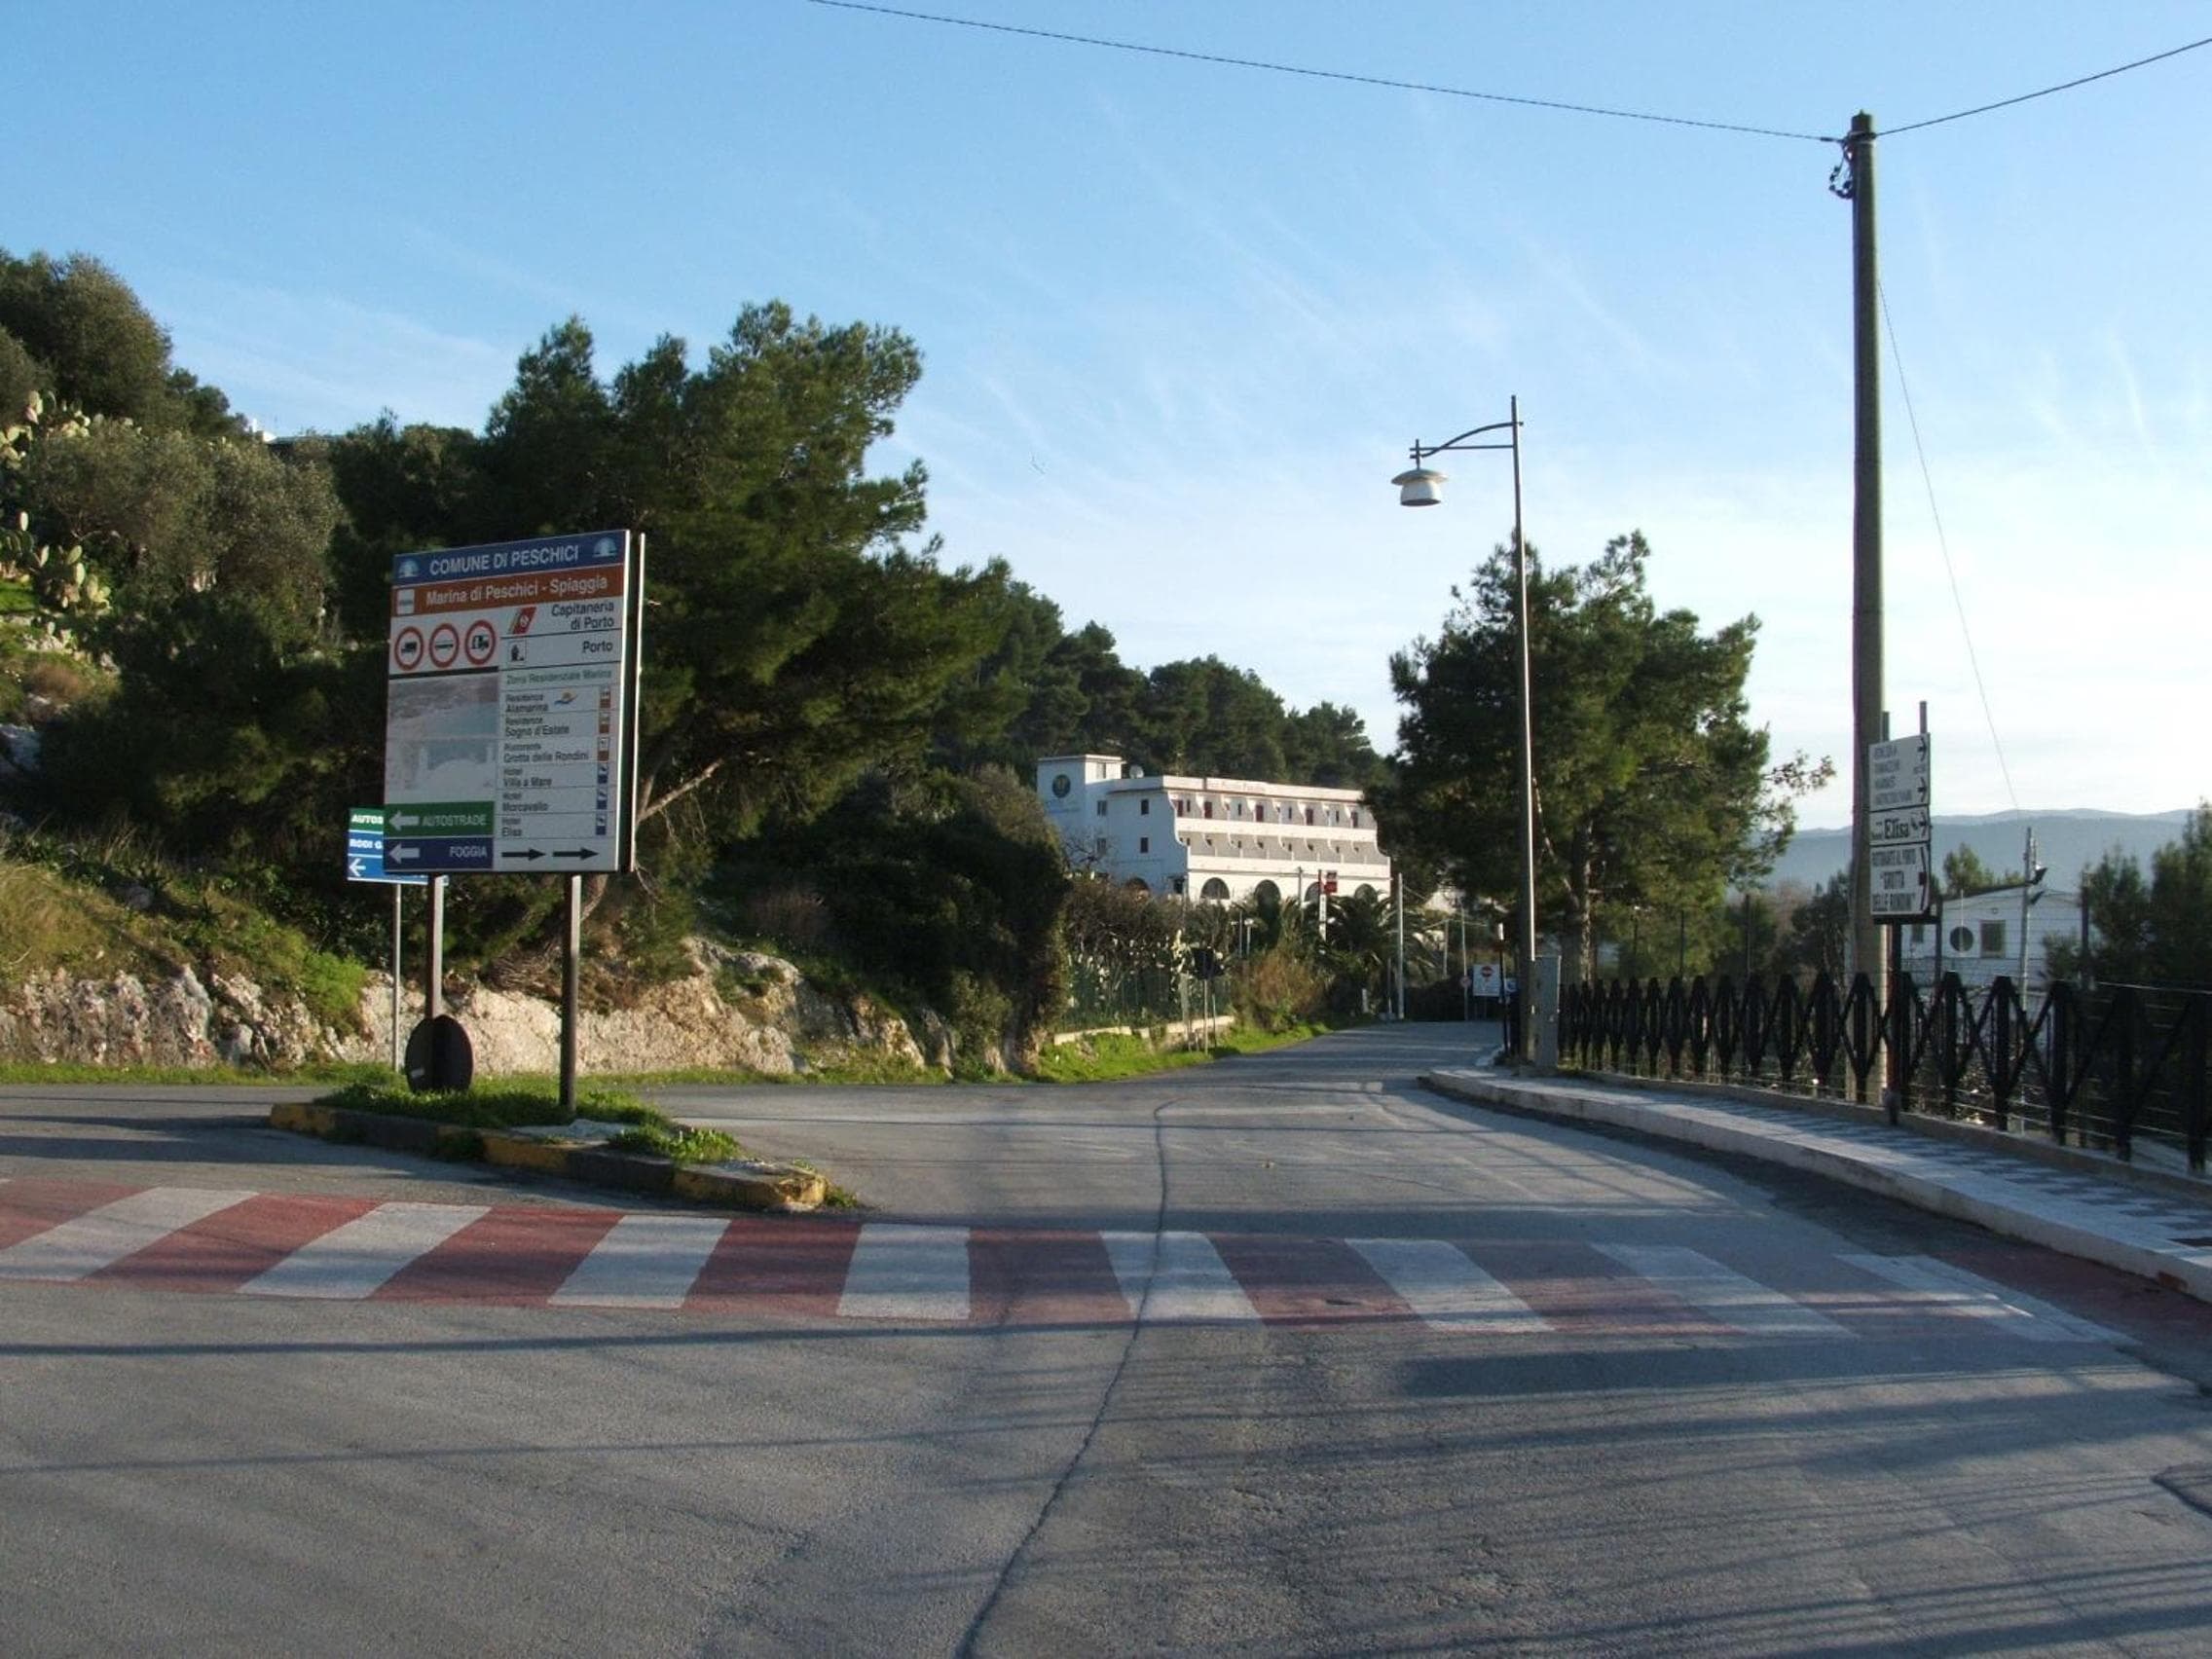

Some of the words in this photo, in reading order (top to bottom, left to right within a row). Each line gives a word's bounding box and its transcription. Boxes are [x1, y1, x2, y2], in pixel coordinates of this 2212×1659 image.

[429, 555, 491, 575] COMUNE
[494, 554, 507, 568] DI
[511, 545, 578, 566] PESCHICI
[426, 589, 467, 605] Marina
[470, 586, 482, 600] di
[487, 581, 537, 600] Peschici
[550, 574, 608, 594] Spiaggia
[551, 601, 614, 616] Capitaneria
[571, 618, 580, 630] di
[585, 616, 614, 629] Porto
[583, 641, 612, 653] Porto
[422, 814, 487, 827] AUTOSTRADE
[349, 838, 372, 849] RODI
[449, 845, 488, 858] FOGGIA
